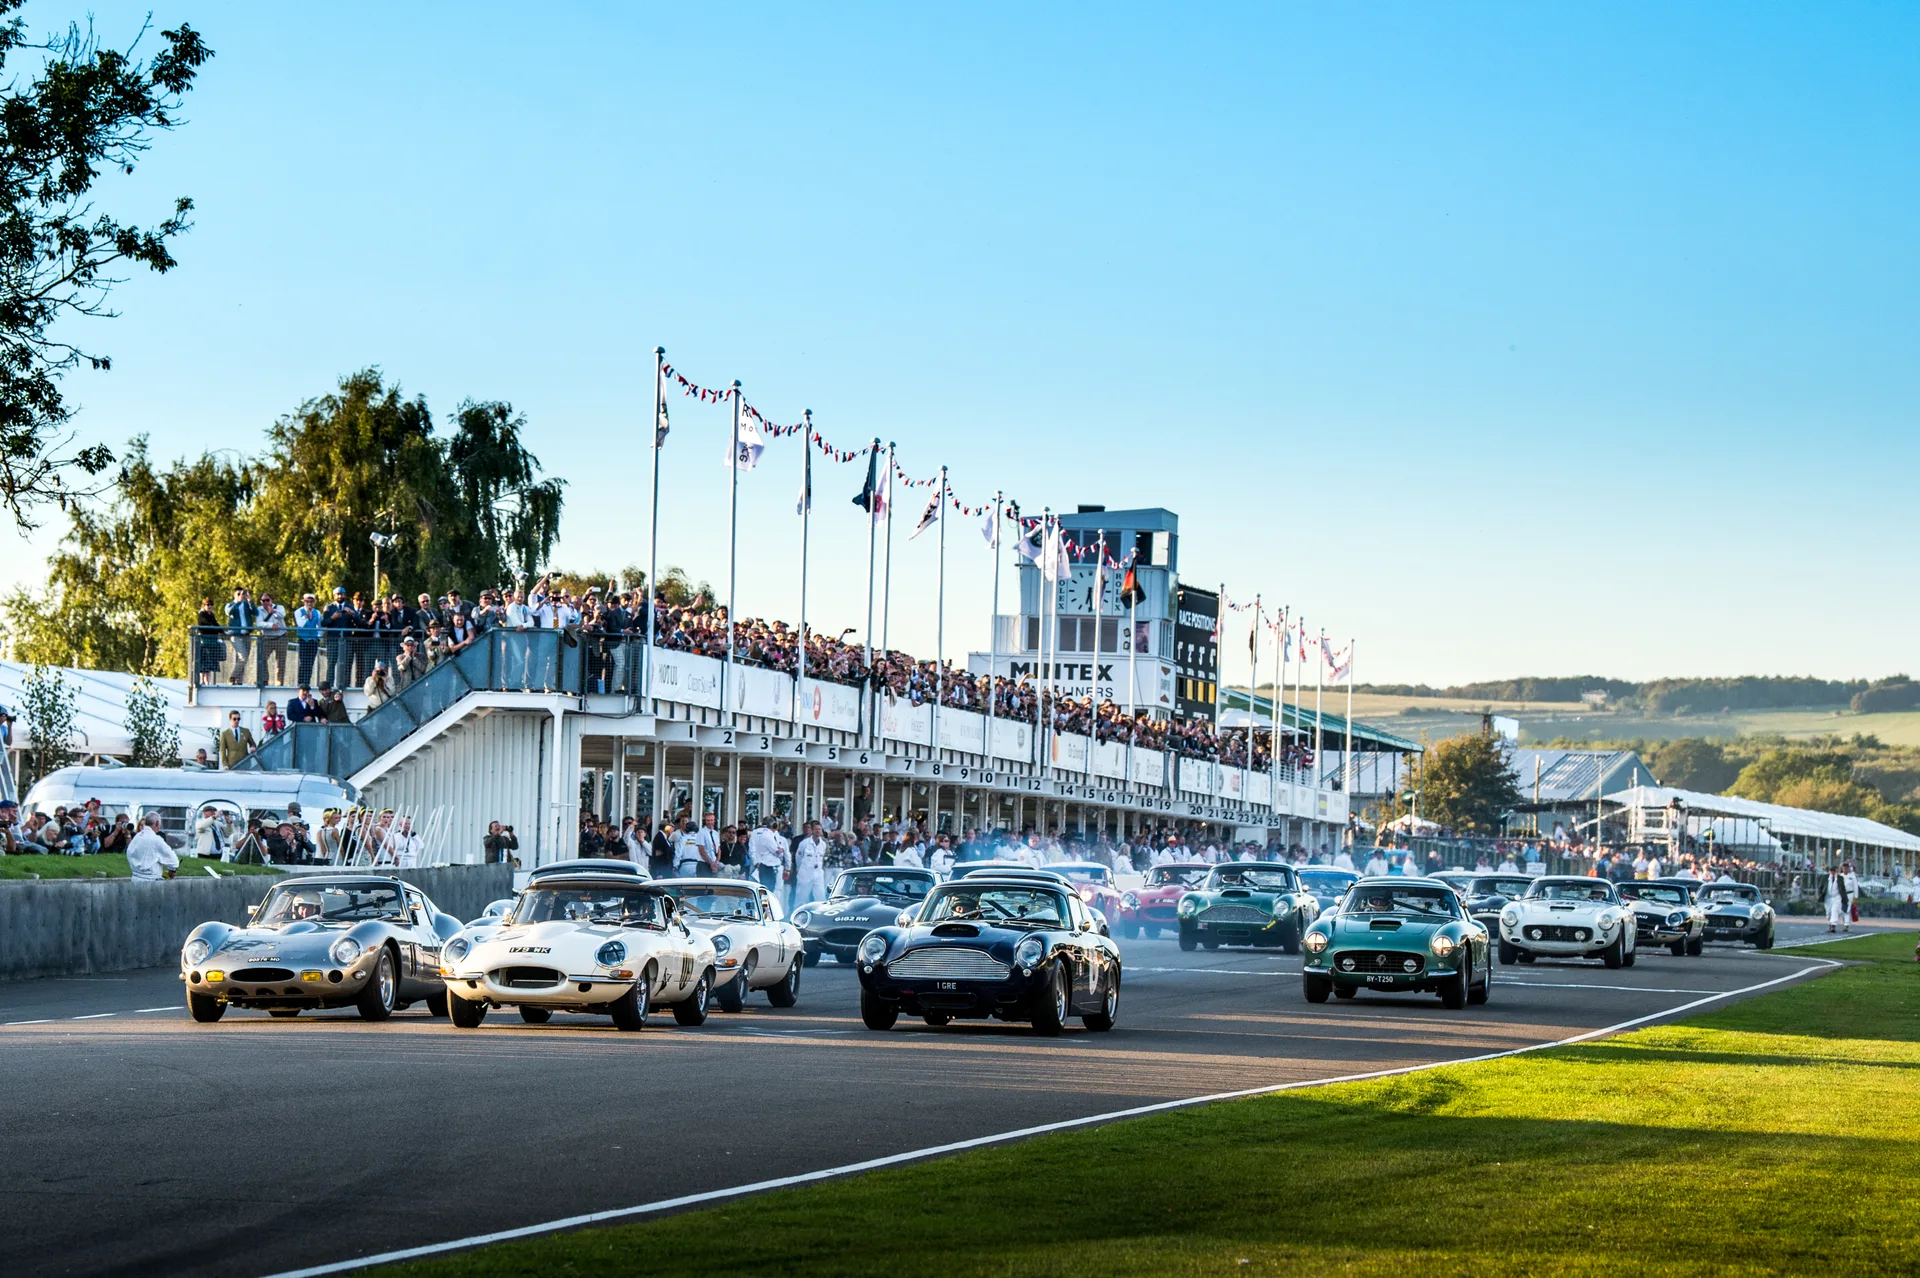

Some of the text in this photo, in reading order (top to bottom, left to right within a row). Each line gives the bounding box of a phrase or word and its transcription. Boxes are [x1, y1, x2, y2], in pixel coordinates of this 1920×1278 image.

[1058, 580, 1066, 610] OLEX
[1179, 609, 1216, 633] RACE POSITIONS
[1010, 662, 1113, 681] MINTEX
[689, 725, 693, 738] 1
[723, 731, 733, 744] 2
[760, 737, 769, 749] 3
[795, 743, 804, 754] 4
[828, 748, 836, 760] 5
[860, 752, 868, 764] 6
[904, 760, 912, 771] 7
[933, 764, 940, 775] 8
[961, 769, 968, 779] 9
[980, 772, 993, 783] 10
[1007, 777, 1017, 787] 11
[1028, 780, 1041, 790] 12
[1060, 785, 1073, 795] 14
[1083, 789, 1095, 799] 15
[1102, 792, 1115, 802] 16
[1122, 794, 1133, 804] 17
[1141, 797, 1153, 807] 18
[1160, 800, 1171, 810] 19
[1190, 805, 1203, 815] 20
[1208, 808, 1219, 818] 21
[1222, 810, 1235, 820] 22
[1238, 813, 1250, 823] 23
[1252, 815, 1263, 825] 24
[1267, 817, 1279, 827] 25
[941, 981, 957, 990] GRE
